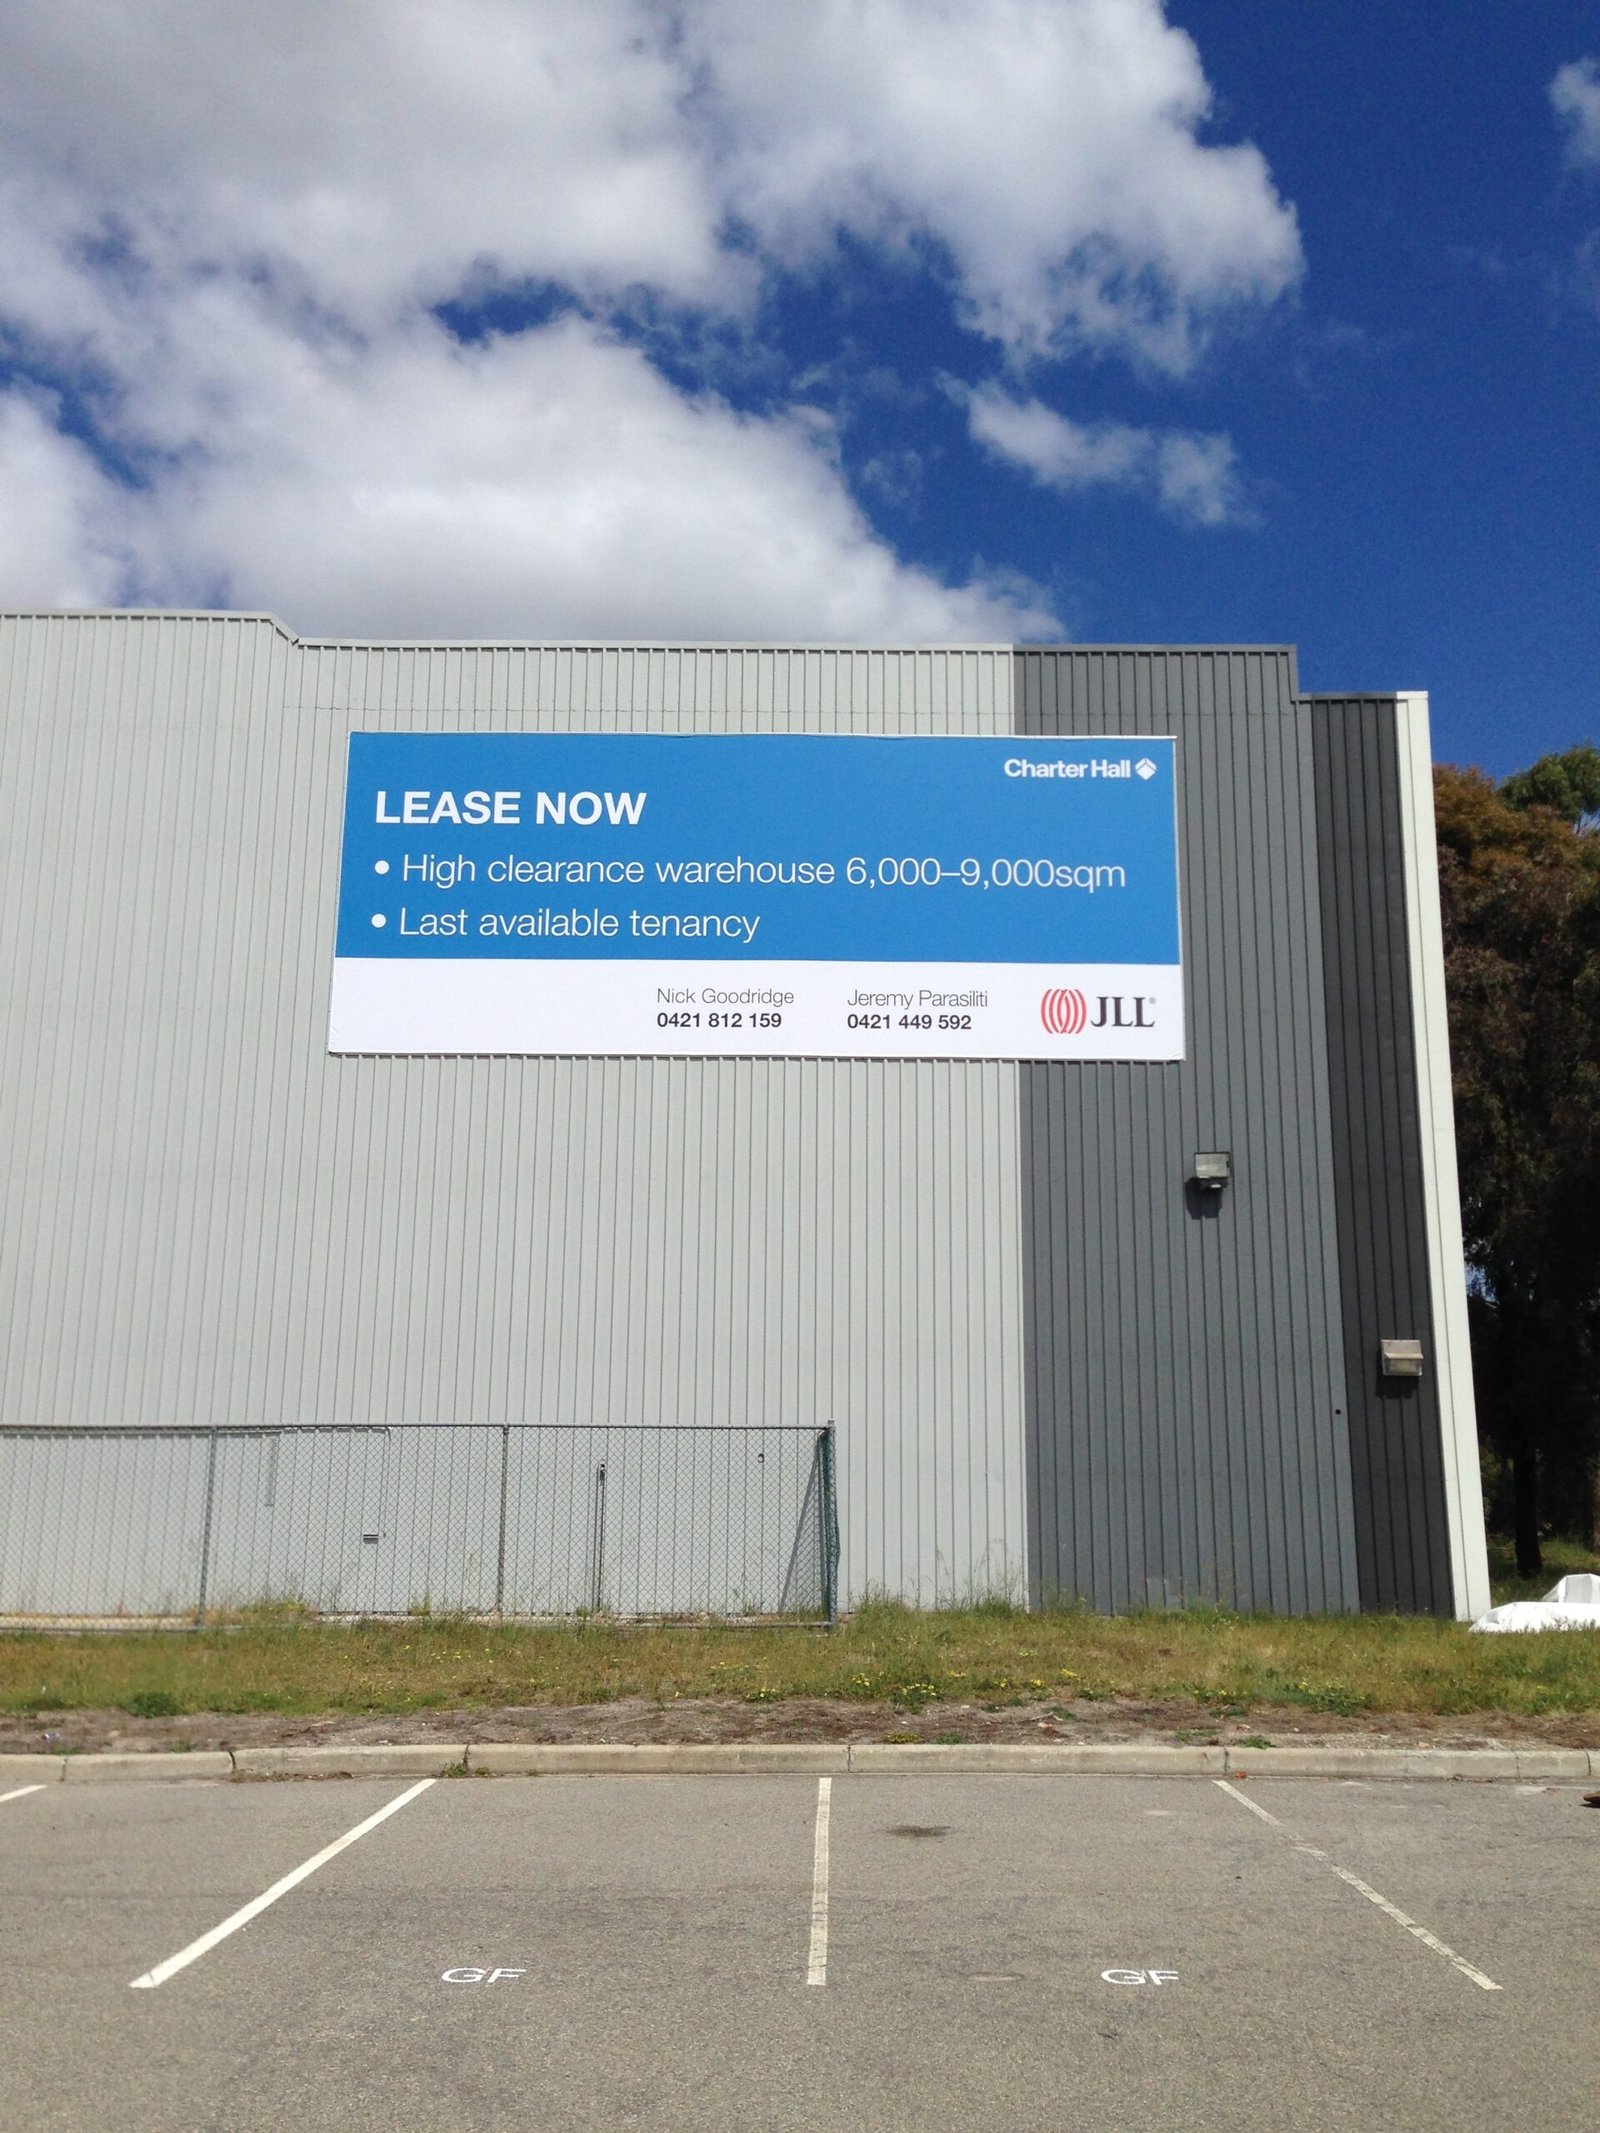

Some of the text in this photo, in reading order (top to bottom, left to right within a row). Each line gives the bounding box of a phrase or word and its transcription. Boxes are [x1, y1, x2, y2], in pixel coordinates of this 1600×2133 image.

[1003, 758, 1132, 779] Charter Hall
[375, 790, 647, 826] LEASE NOW
[403, 854, 476, 889] High
[487, 854, 645, 883] clearance
[655, 855, 835, 884] warehouse
[400, 907, 761, 944] Last available tenancy
[657, 988, 795, 1008] Nick Goodridge
[847, 989, 988, 1011] Jeremy Parasiliti
[656, 1012, 782, 1028] 0421 812 159
[847, 1013, 972, 1030] 0421 449 592
[438, 1966, 527, 1985] GF
[1100, 1968, 1180, 1986] GF
